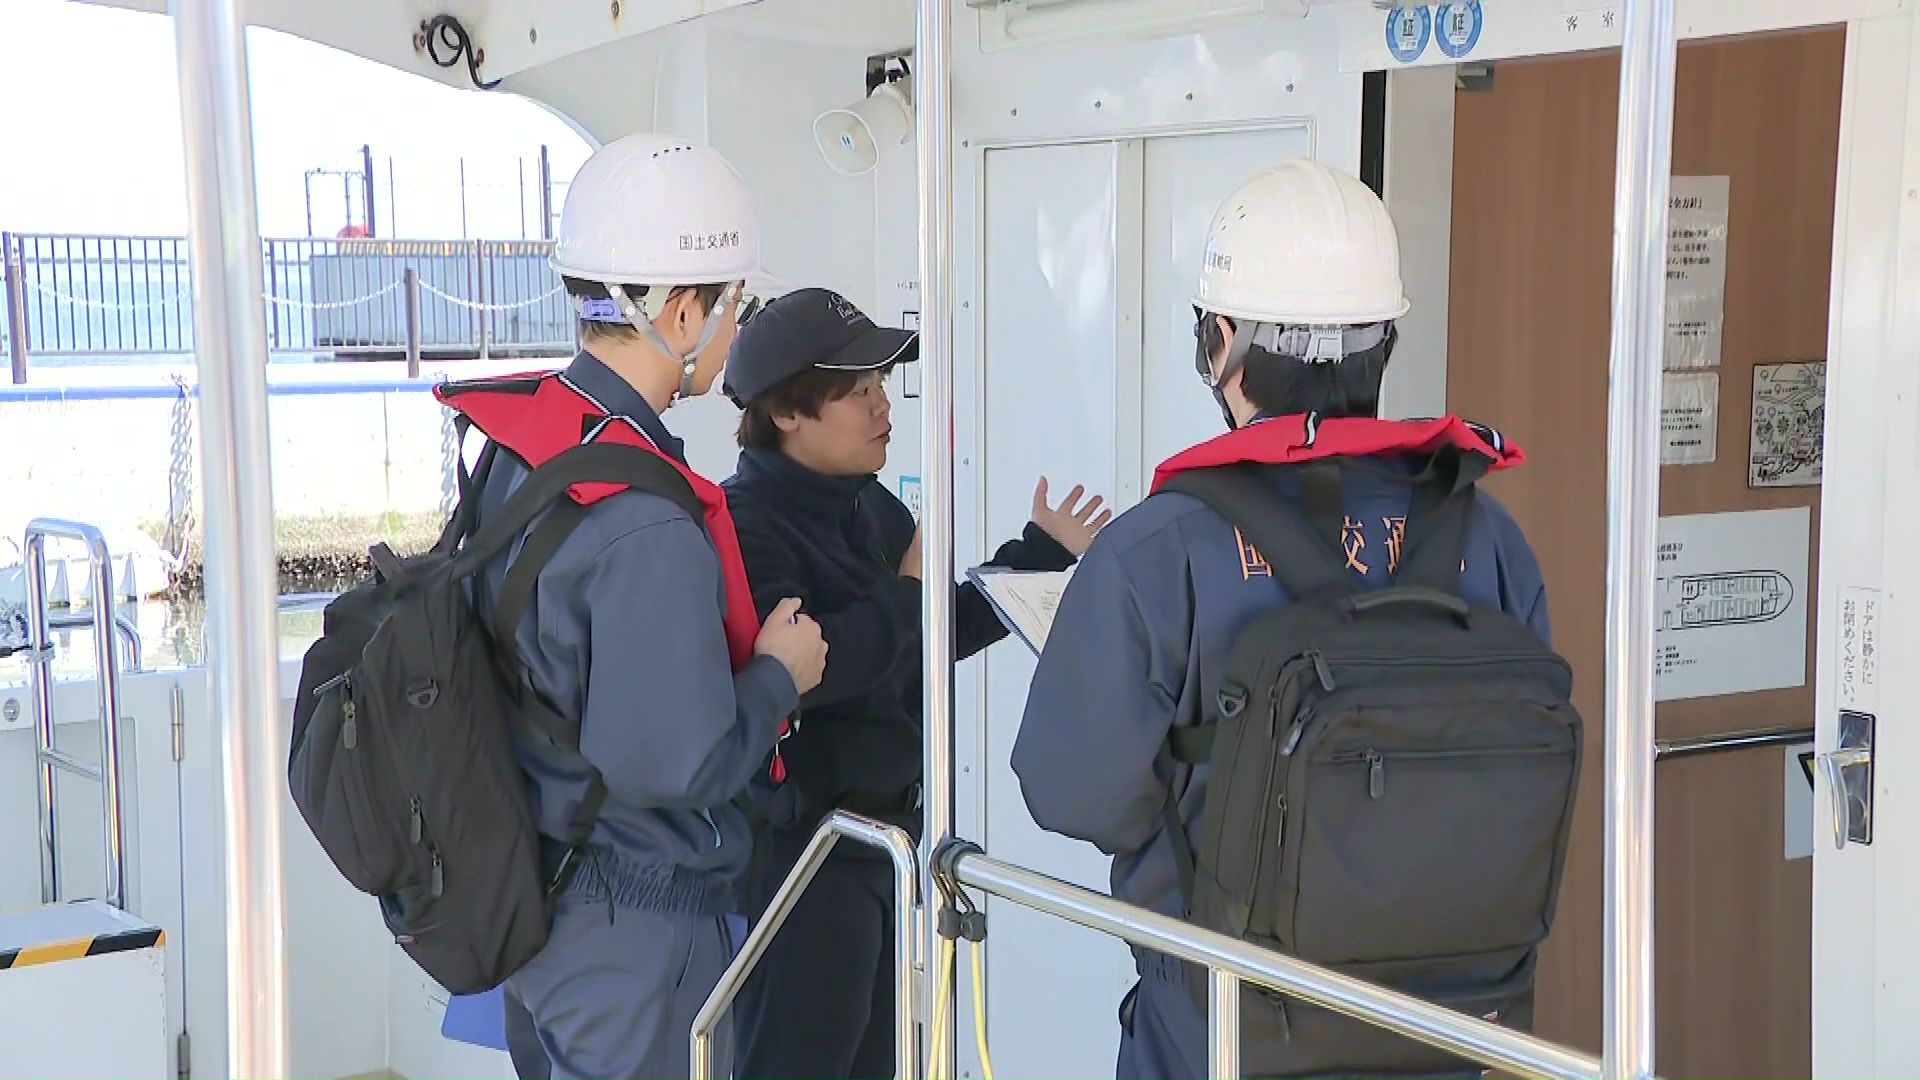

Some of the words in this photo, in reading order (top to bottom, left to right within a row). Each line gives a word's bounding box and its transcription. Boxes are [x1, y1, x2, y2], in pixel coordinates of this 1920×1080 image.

[679, 231, 740, 251] 国土交通省
[1843, 599, 1856, 703] お閉めください。
[1862, 599, 1875, 685] ドアは静かに
